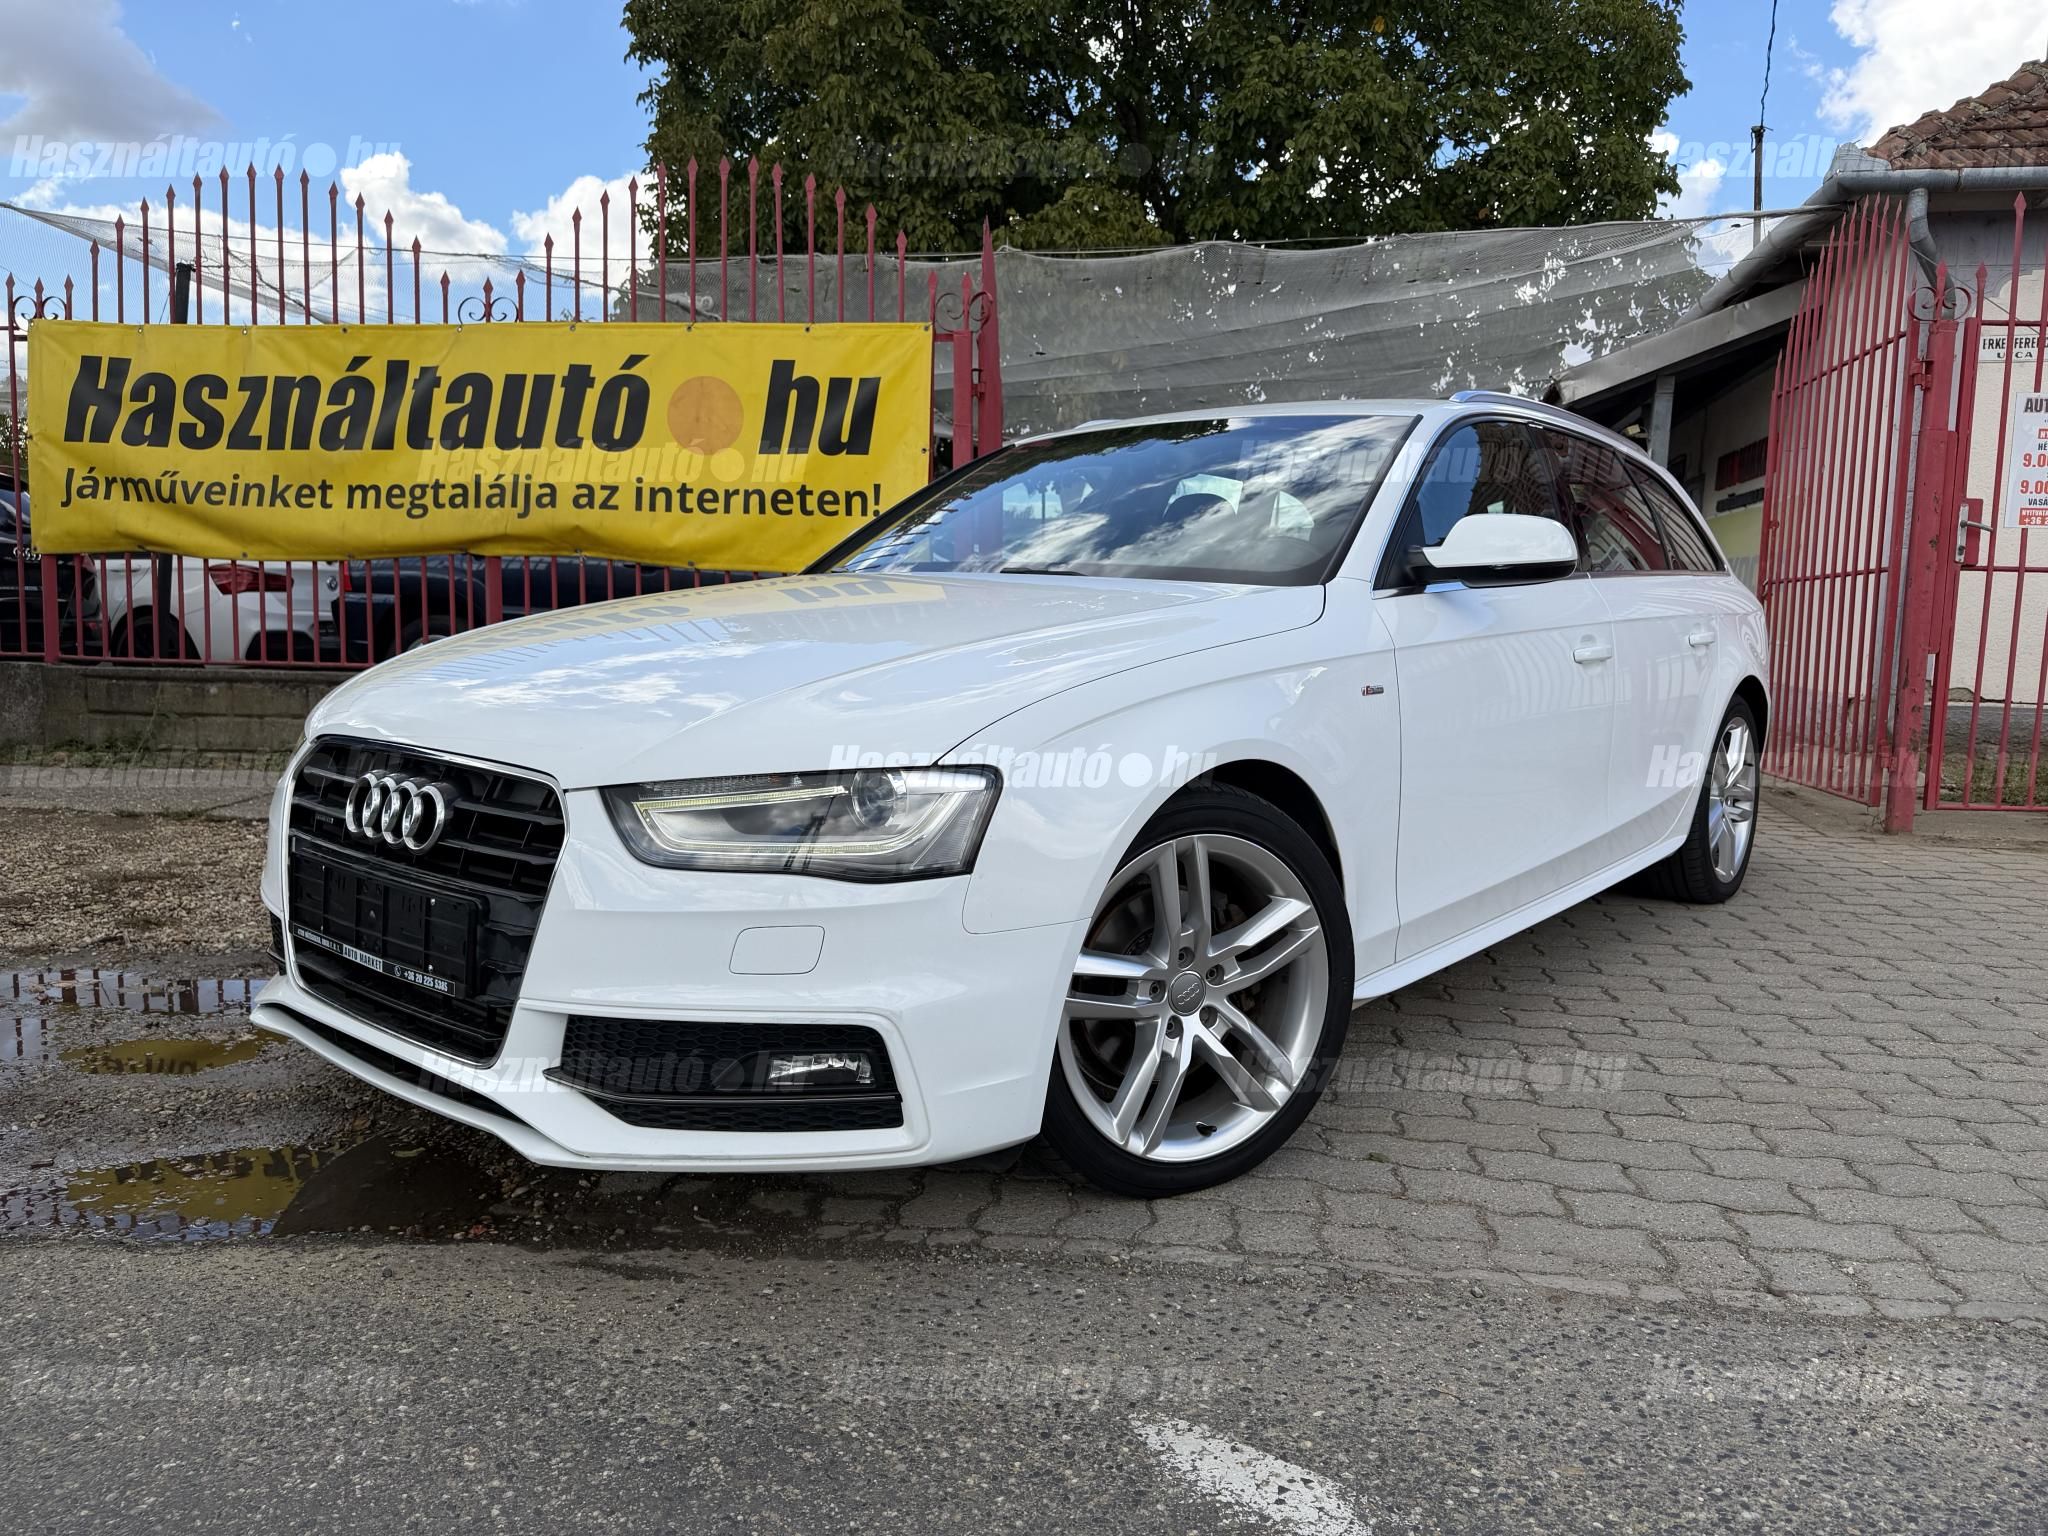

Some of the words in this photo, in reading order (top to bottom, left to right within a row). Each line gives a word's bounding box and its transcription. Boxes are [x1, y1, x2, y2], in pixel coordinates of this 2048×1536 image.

[1982, 337, 2007, 350] ERKE
[2014, 337, 2048, 349] FERE
[1997, 351, 2033, 359] UCA
[64, 354, 650, 453] Használtautó
[2023, 453, 2048, 468] 9.0
[61, 467, 333, 509] Járműveinket
[348, 473, 558, 519] megtalálja
[573, 482, 619, 511] az
[635, 477, 882, 517] interneten!
[344, 946, 357, 961] AUTO
[359, 950, 382, 970] MARKET
